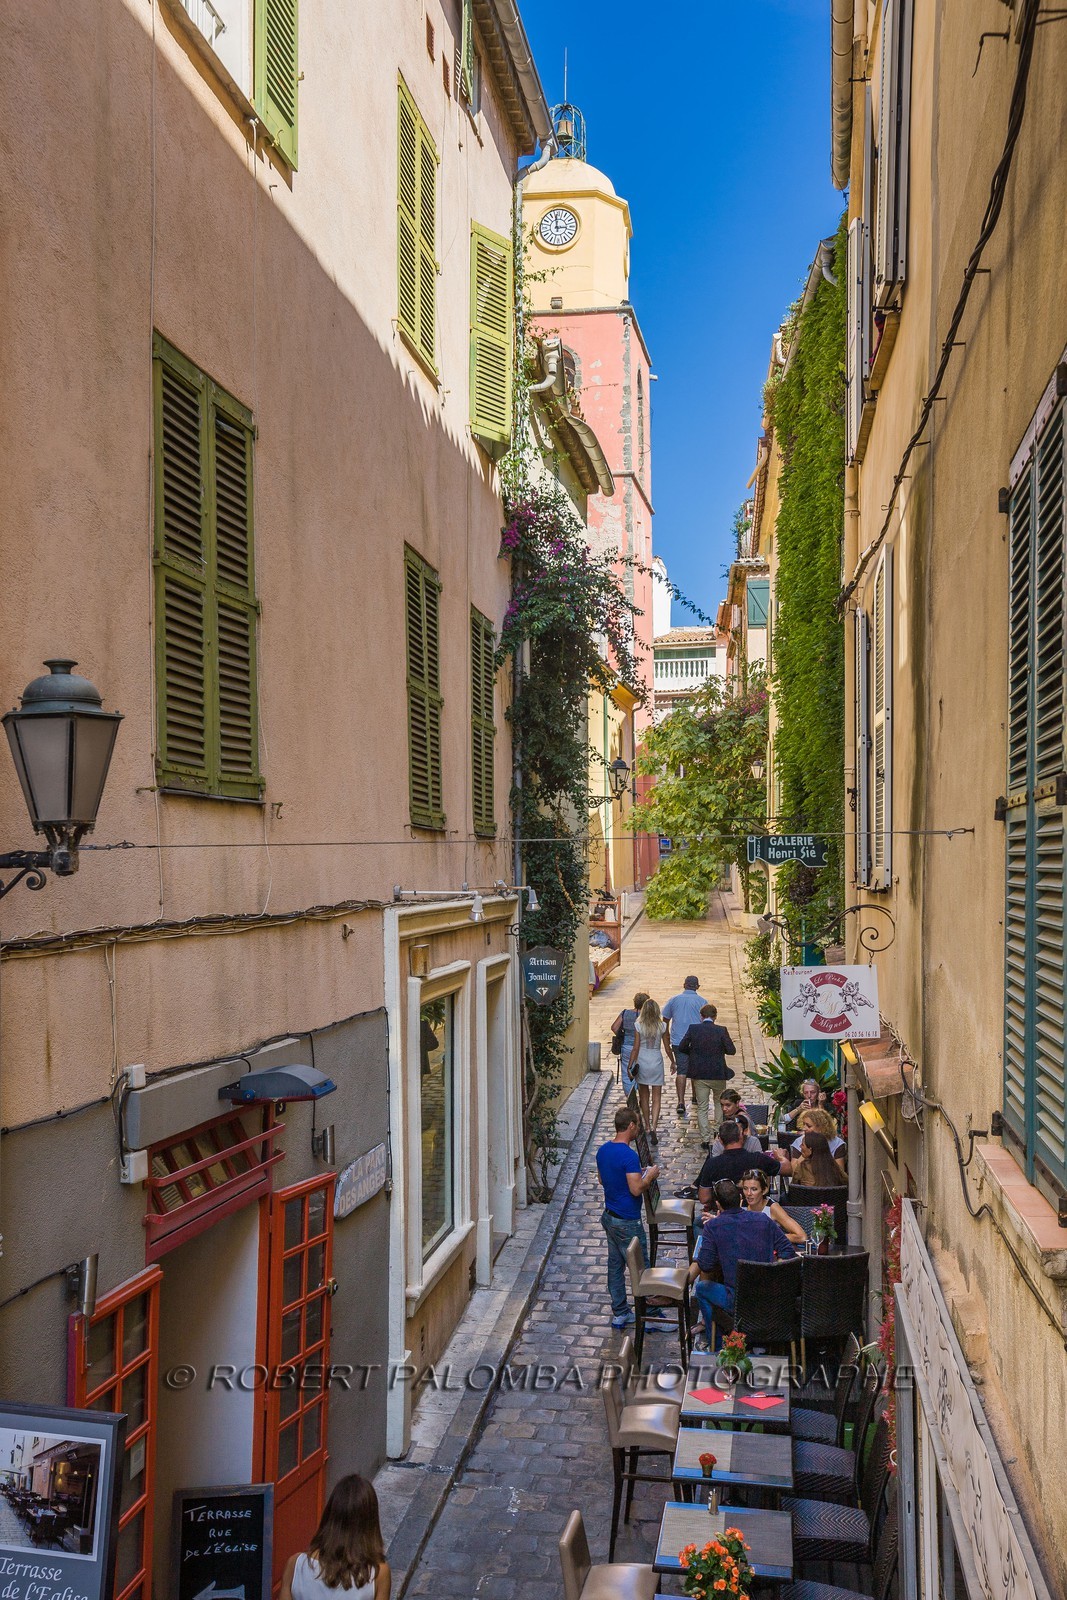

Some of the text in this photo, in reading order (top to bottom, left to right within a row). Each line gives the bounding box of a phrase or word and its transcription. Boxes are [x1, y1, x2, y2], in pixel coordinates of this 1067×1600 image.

[769, 836, 814, 846] GALERIE
[768, 846, 817, 859] Henri Sié
[529, 957, 557, 966] Artisan
[528, 972, 557, 982] Joaillier
[815, 1016, 847, 1031] Mignon
[339, 1167, 386, 1215] DES ANGES
[184, 1505, 252, 1522] TERRASSE
[209, 1528, 232, 1538] RUE
[0, 1557, 62, 1581] Terrasse
[1, 1580, 20, 1599] de
